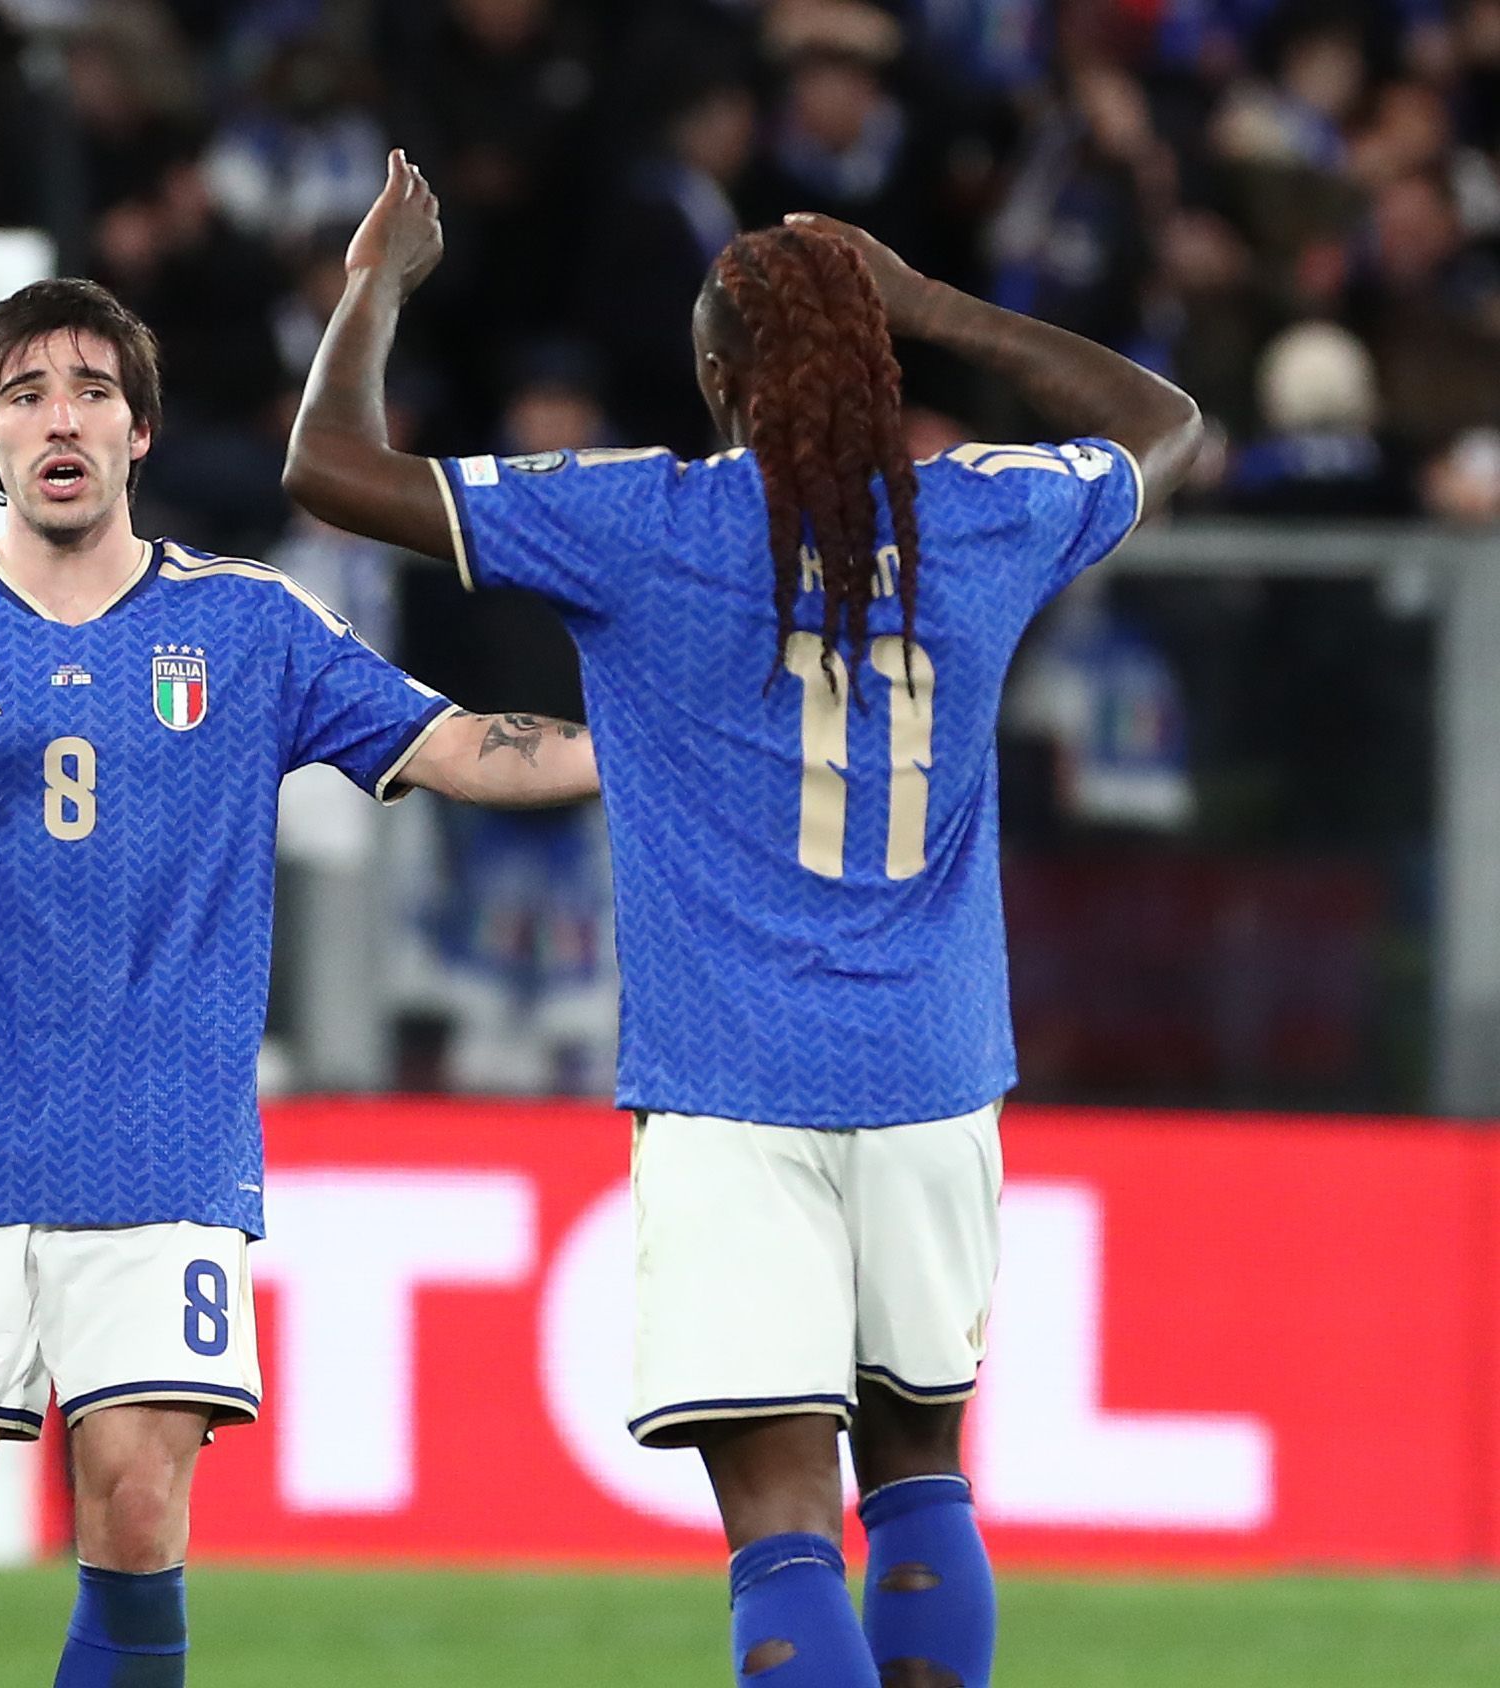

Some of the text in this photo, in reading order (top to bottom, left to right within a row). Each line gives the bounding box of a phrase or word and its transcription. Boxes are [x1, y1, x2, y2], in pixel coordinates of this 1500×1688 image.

[799, 543, 901, 599] KN
[157, 662, 201, 677] ITALIA
[43, 736, 97, 841] 8
[785, 631, 935, 880] 11
[184, 1258, 229, 1357] 8
